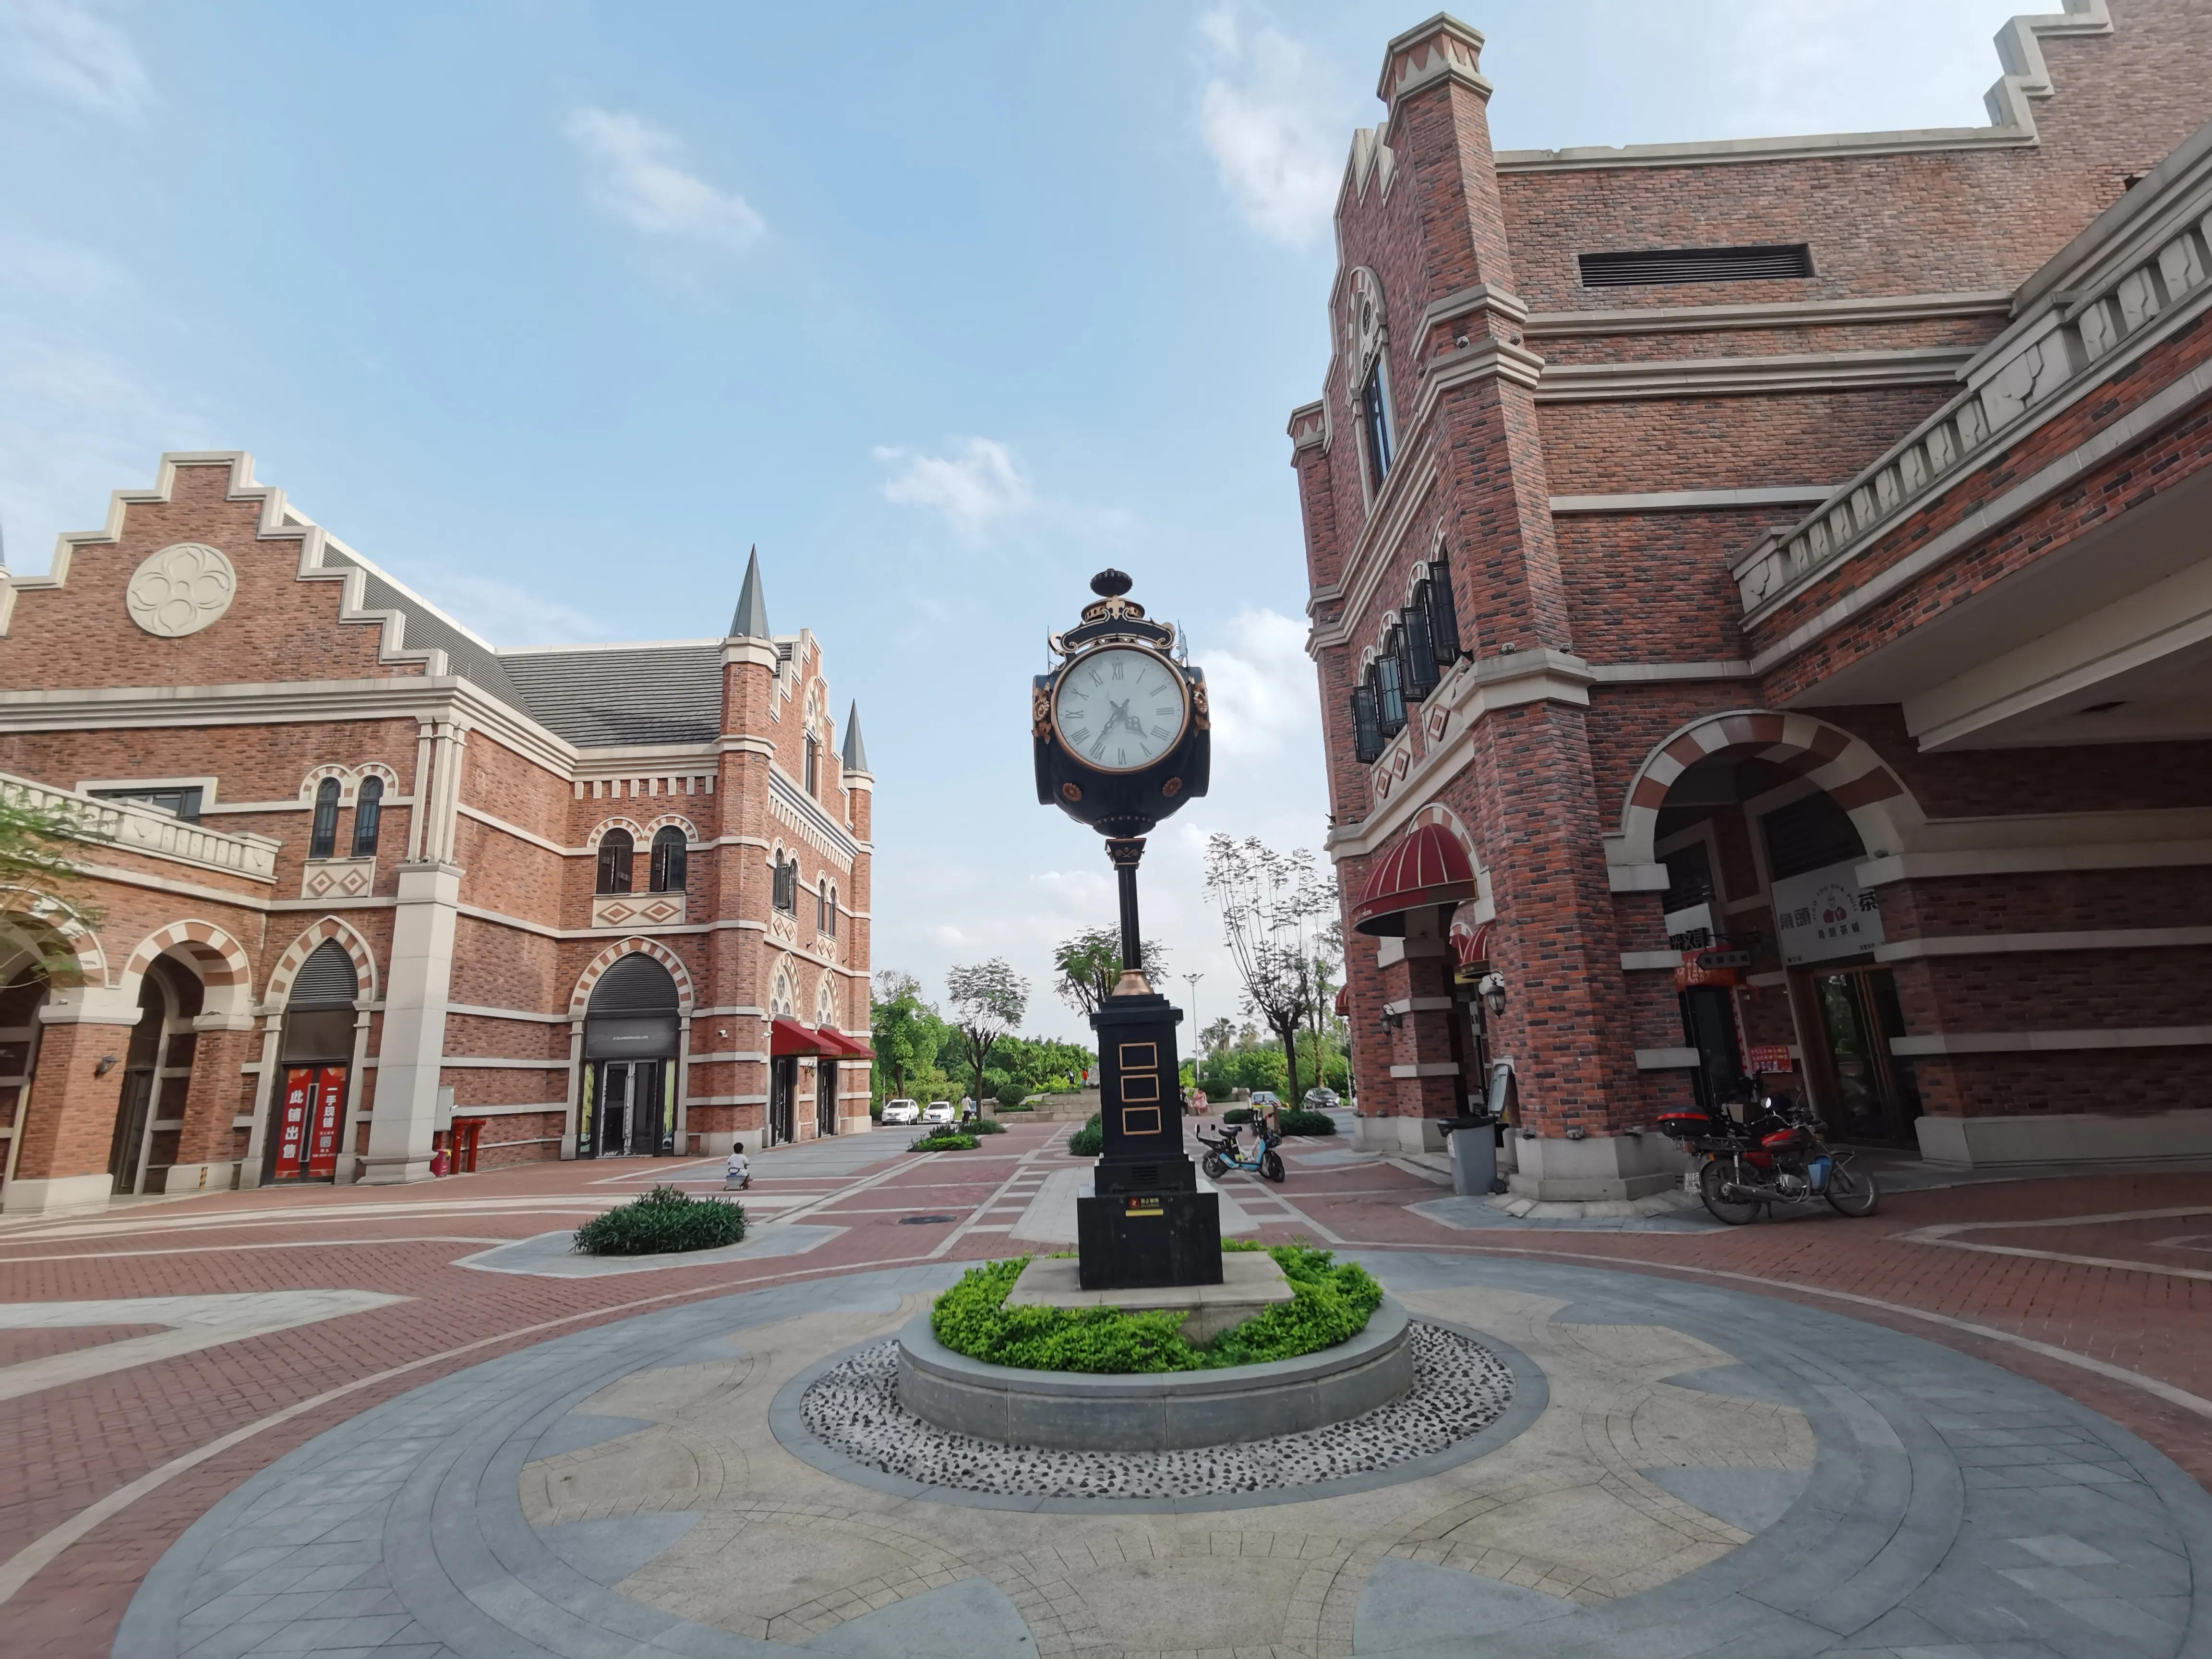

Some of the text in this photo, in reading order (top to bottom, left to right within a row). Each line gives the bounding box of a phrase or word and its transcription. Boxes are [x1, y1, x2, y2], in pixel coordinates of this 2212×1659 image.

[1088, 669, 1103, 687] XI
[1111, 663, 1123, 680] XII
[1071, 687, 1089, 701] X
[1156, 707, 1175, 716] III
[1118, 747, 1127, 765] VI
[1140, 742, 1152, 757] V
[283, 1090, 303, 1158] 此铺出售
